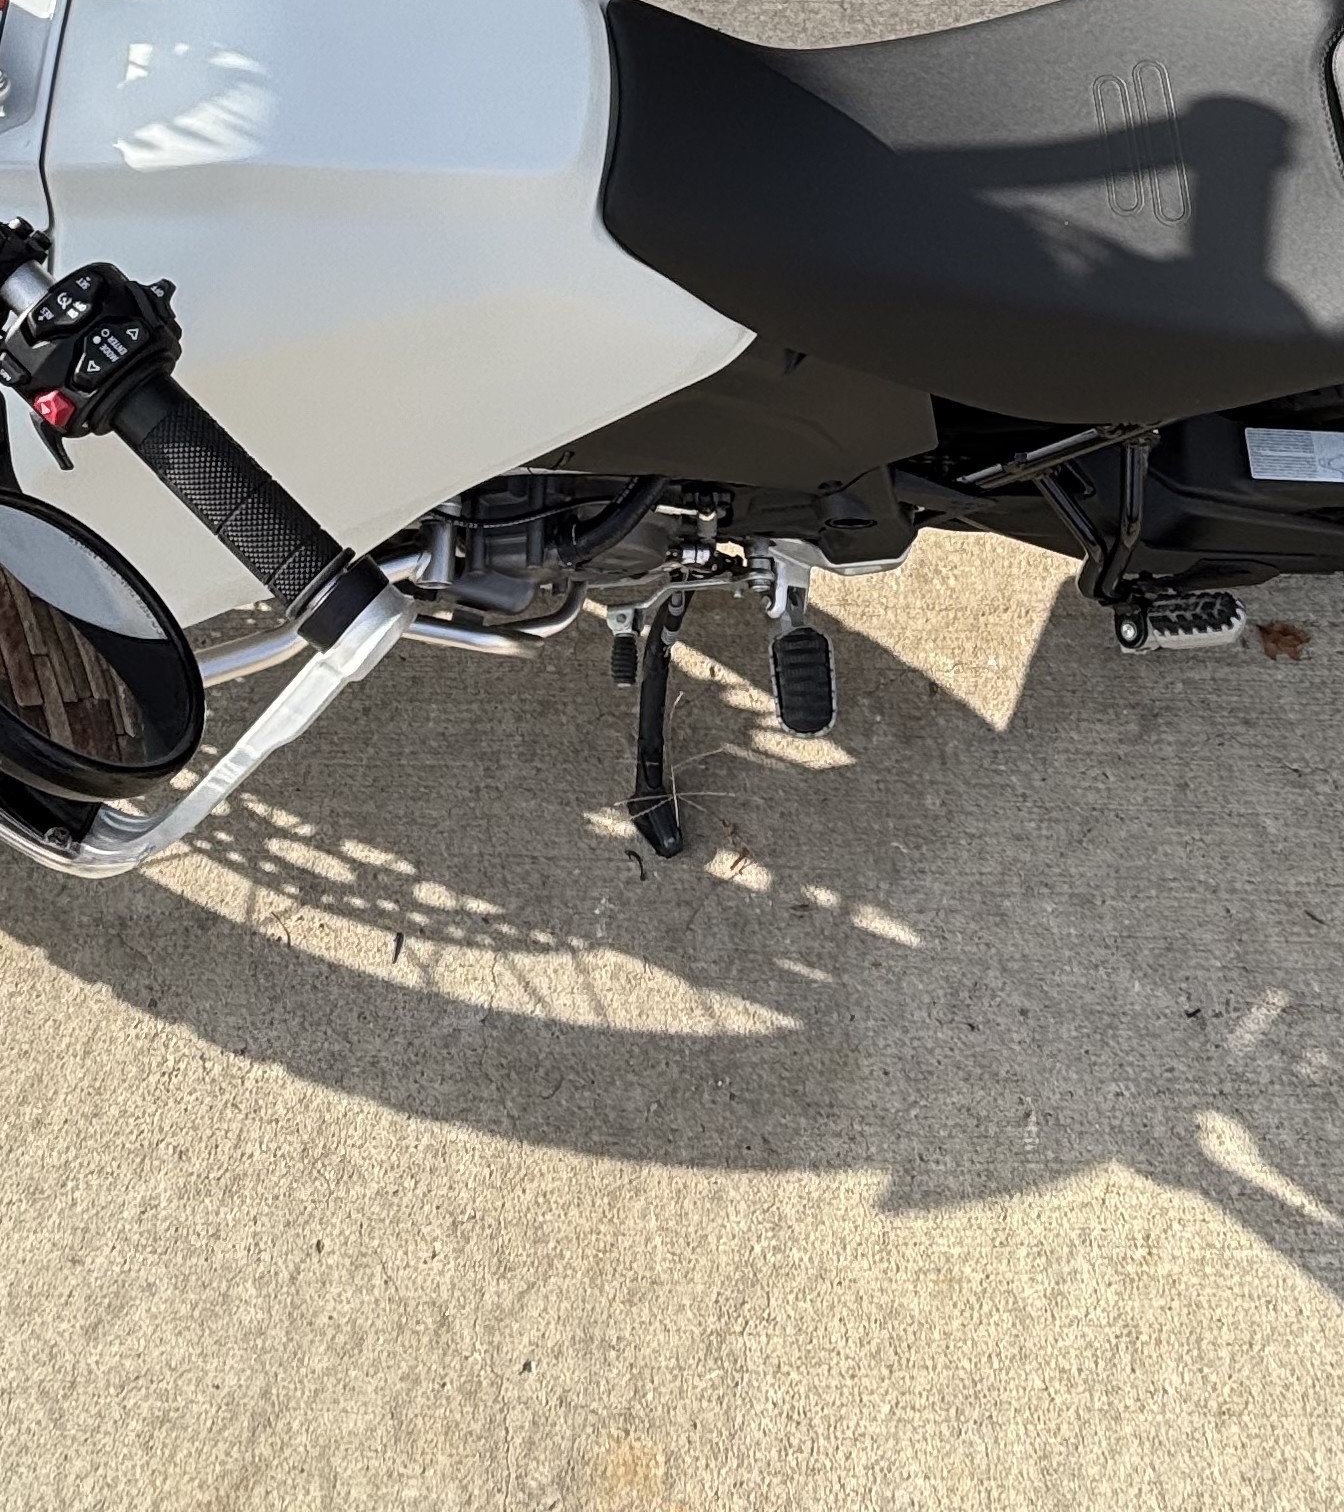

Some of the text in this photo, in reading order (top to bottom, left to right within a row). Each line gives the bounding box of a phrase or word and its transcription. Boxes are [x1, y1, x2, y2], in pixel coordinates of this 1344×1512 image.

[76, 277, 90, 290] SET
[40, 307, 54, 320] RES
[99, 343, 120, 362] MODE
[107, 336, 128, 355] ENTER
